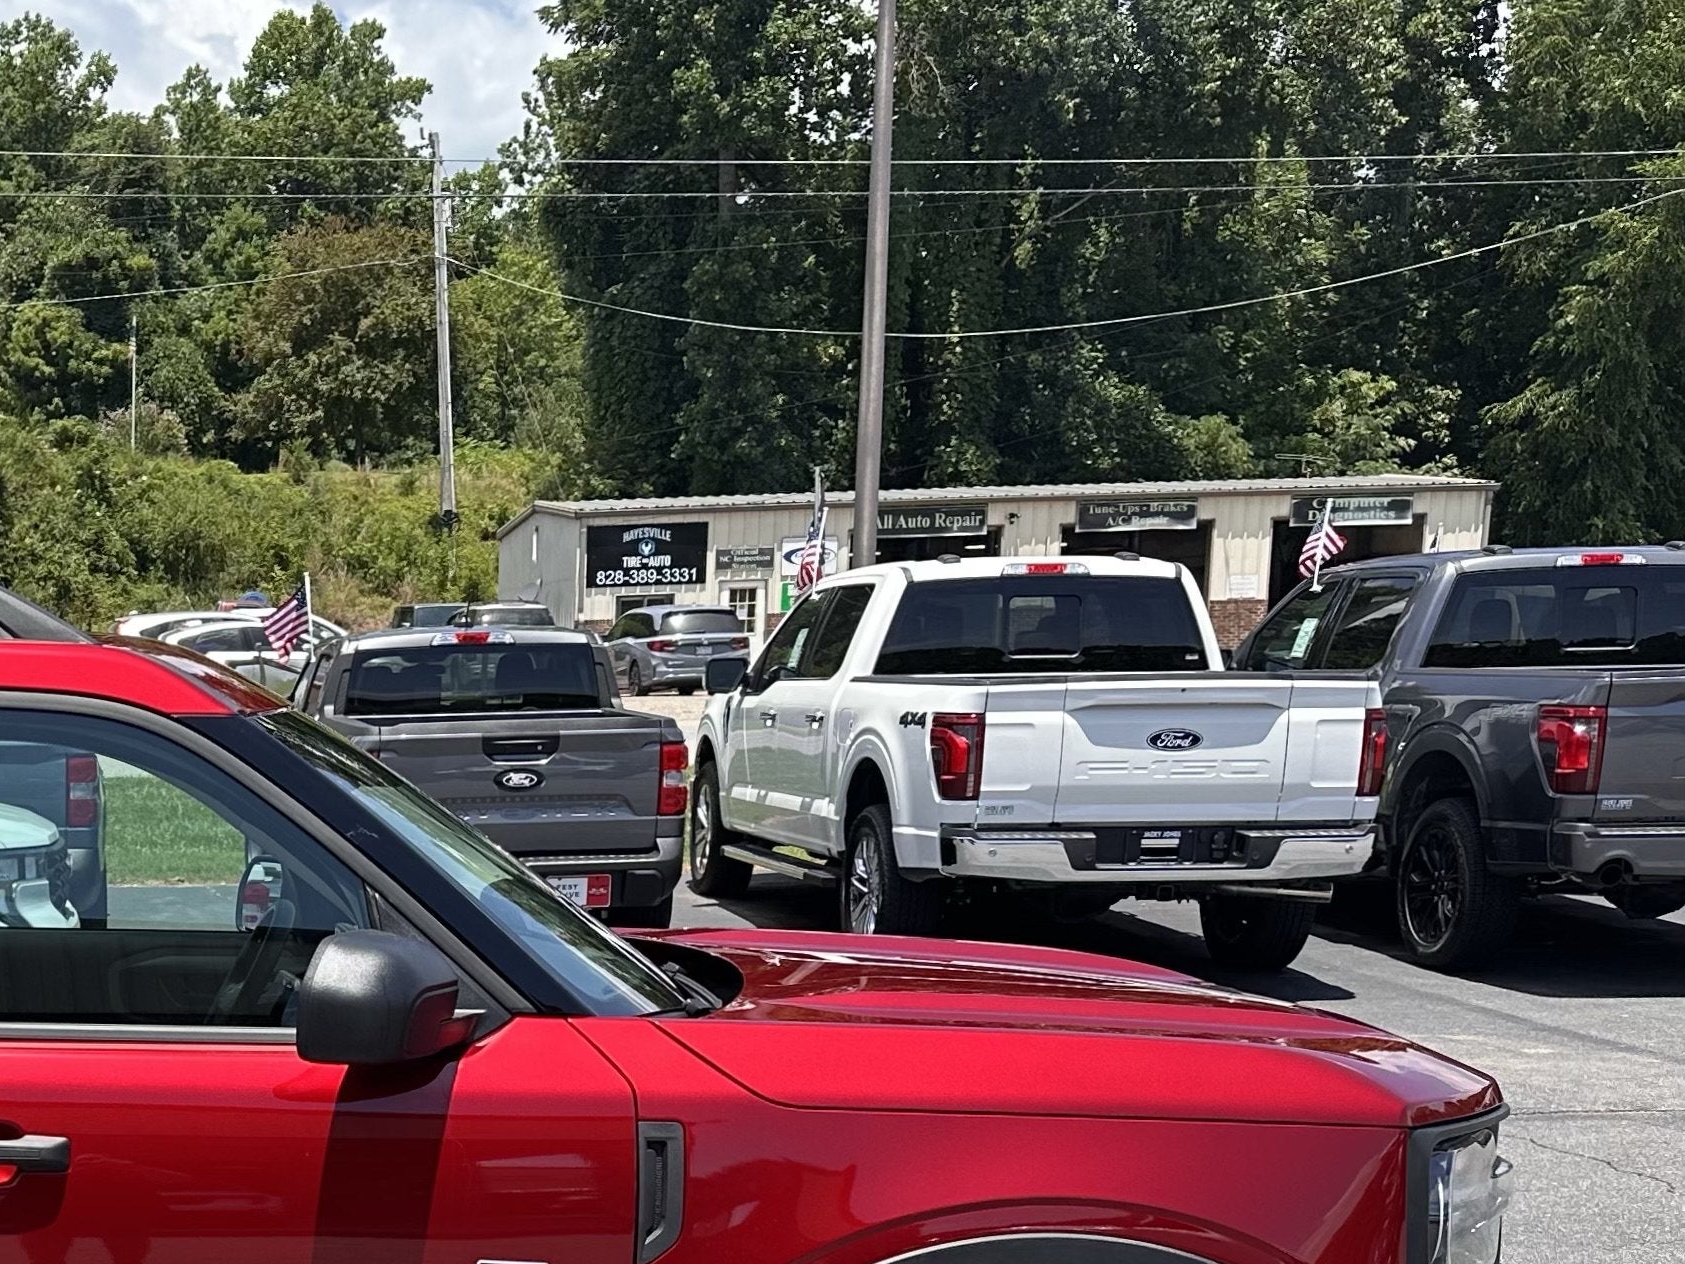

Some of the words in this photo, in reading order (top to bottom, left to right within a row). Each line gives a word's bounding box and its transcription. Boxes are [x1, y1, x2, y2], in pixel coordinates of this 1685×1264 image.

[1089, 504, 1140, 515] Tune-Ups
[1150, 503, 1188, 512] Brakes
[1308, 509, 1396, 521] Dgnostics
[876, 514, 893, 529] All
[895, 514, 931, 529] Auto
[935, 511, 983, 531] Repair
[1106, 515, 1128, 526] A/C
[622, 527, 672, 542] HAYESVILLE
[622, 556, 642, 568] TIRE
[648, 555, 672, 567] AUTO
[596, 567, 697, 585] 828-389-3331
[1155, 731, 1195, 748] Ford
[458, 803, 617, 820] AVERICK
